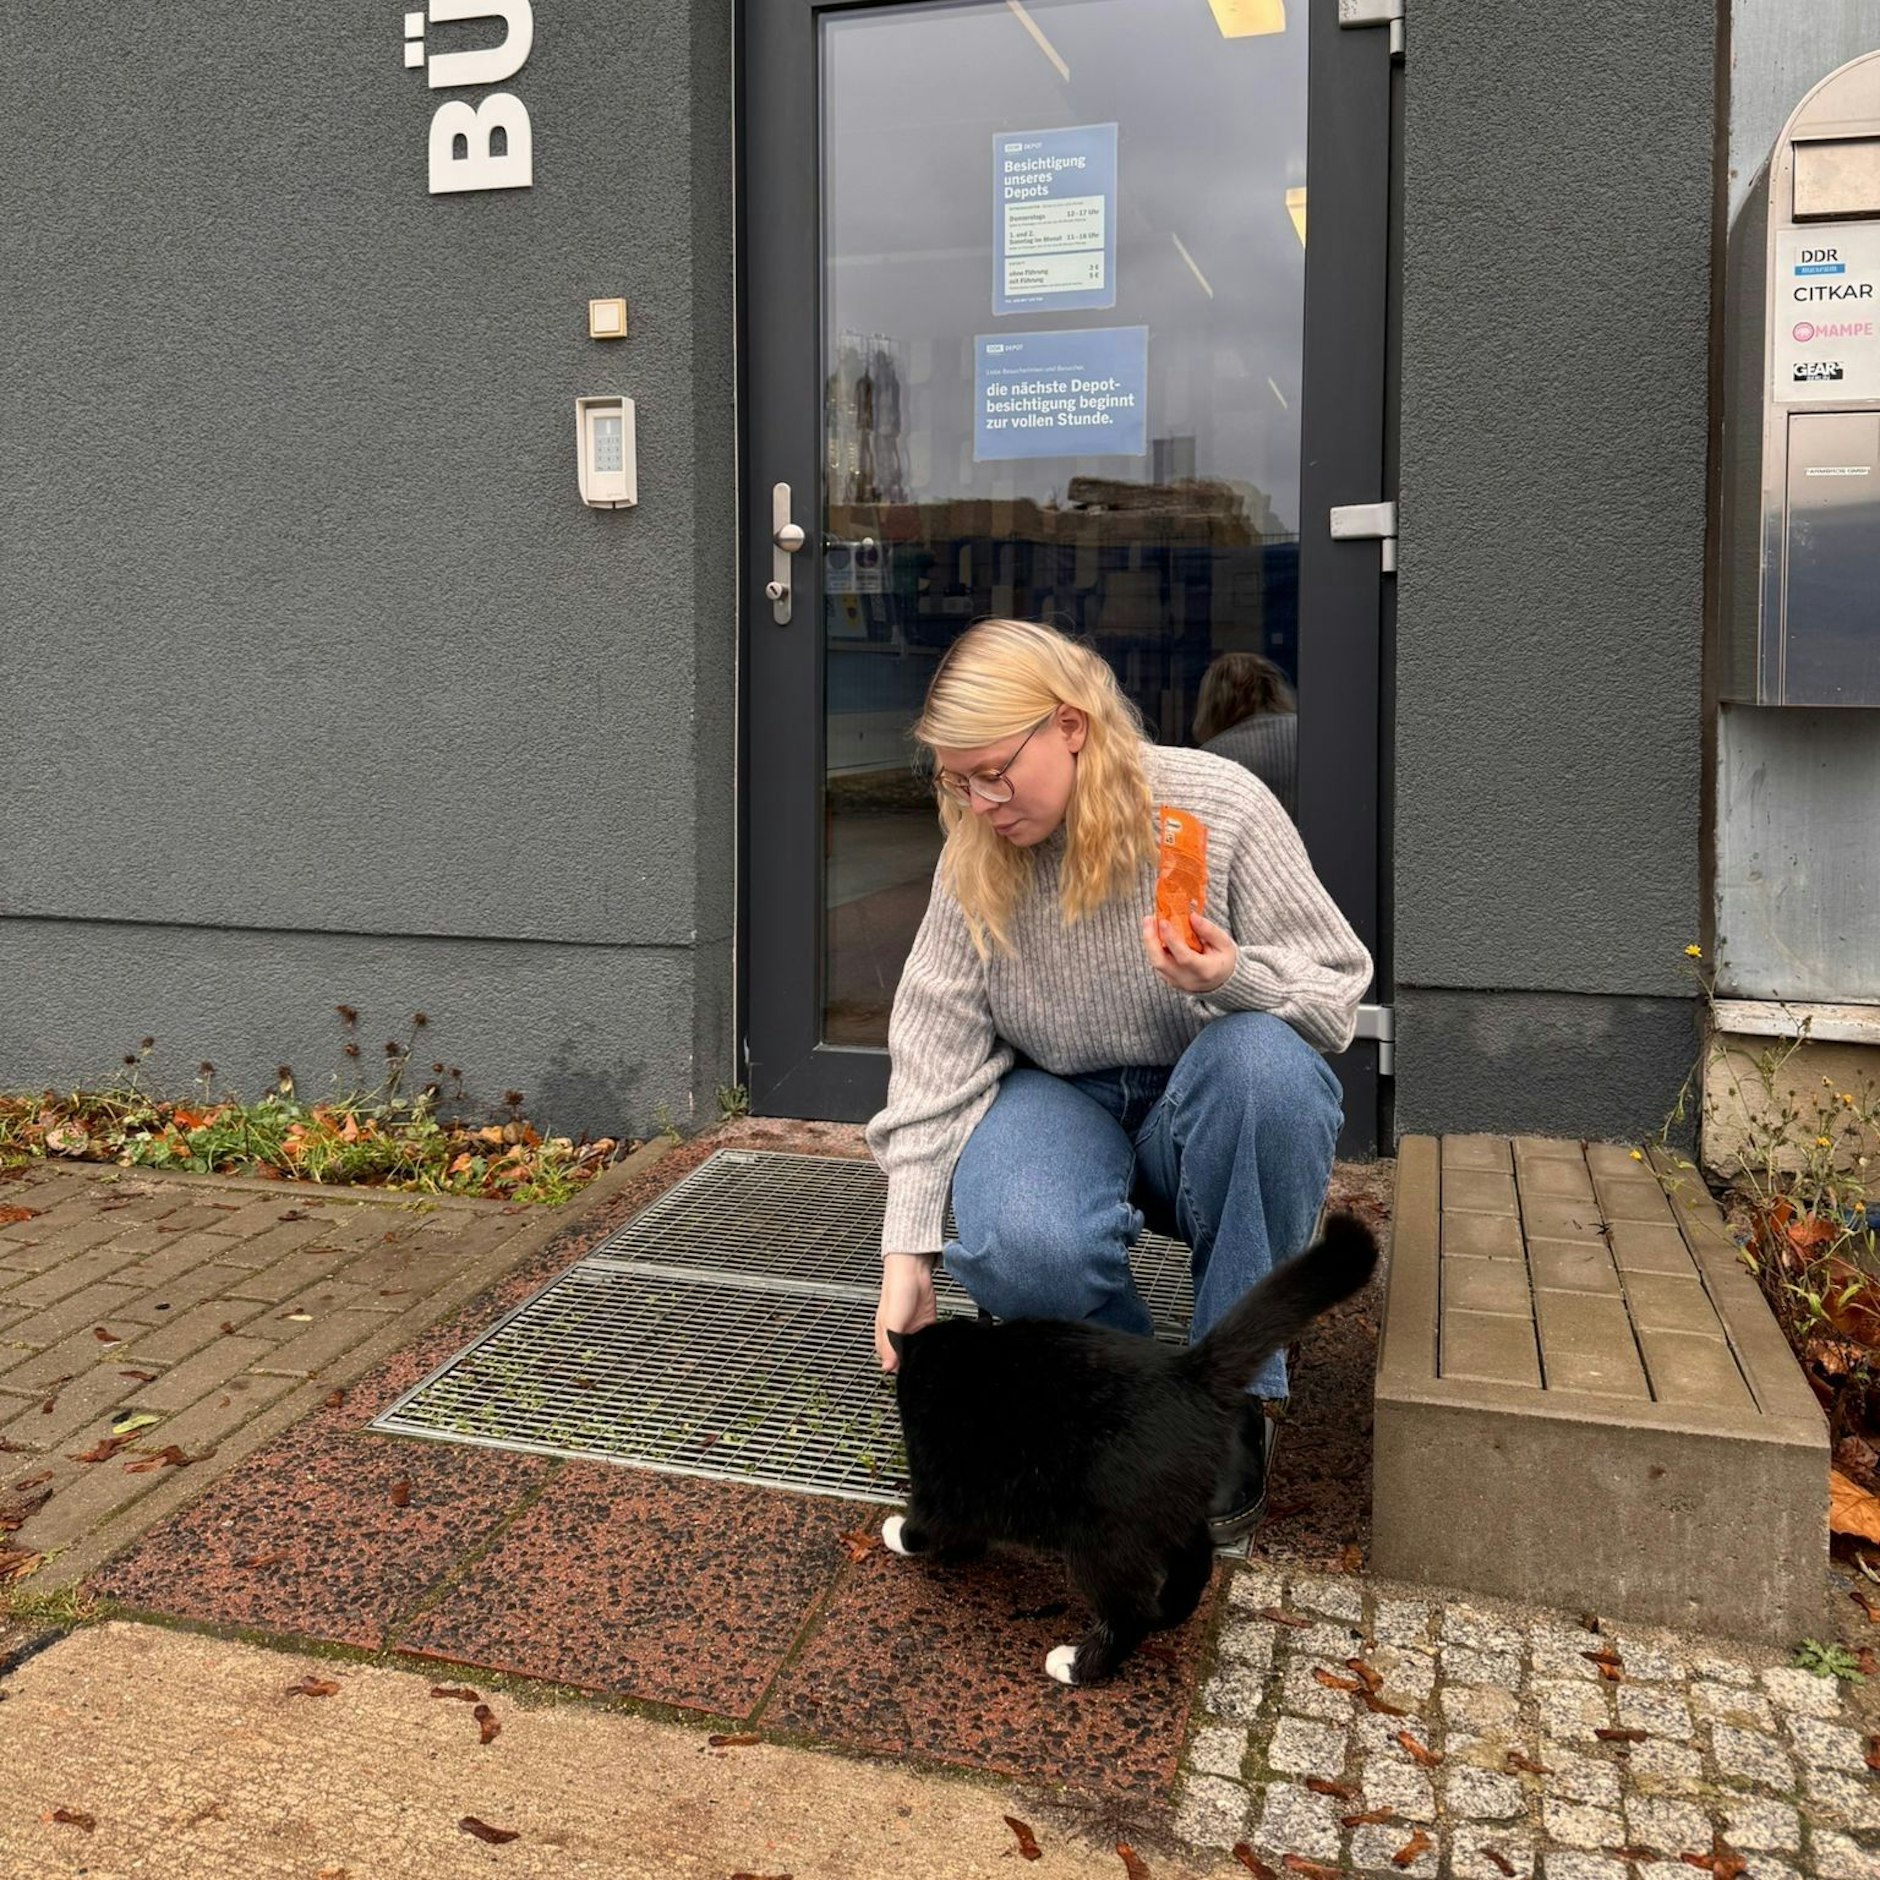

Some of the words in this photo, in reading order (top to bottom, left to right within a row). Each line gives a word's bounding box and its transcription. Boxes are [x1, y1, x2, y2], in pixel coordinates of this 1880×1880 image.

[404, 0, 534, 194] BÜ
[1004, 156, 1086, 173] Besichtigung
[1004, 172, 1052, 186] unseres
[1004, 185, 1048, 200] Depots
[1801, 249, 1838, 263] DDR
[1793, 284, 1874, 302] CITKAR
[1815, 322, 1874, 338] MAMPE
[987, 383, 1007, 396] die
[1011, 380, 1067, 395] nächste
[1071, 377, 1121, 394] Depot-
[986, 397, 1076, 413] besichtigung
[1080, 393, 1135, 411] beginnt
[986, 418, 1008, 429] zur
[1011, 414, 1053, 428] vollen
[1057, 411, 1114, 426] Stunde.
